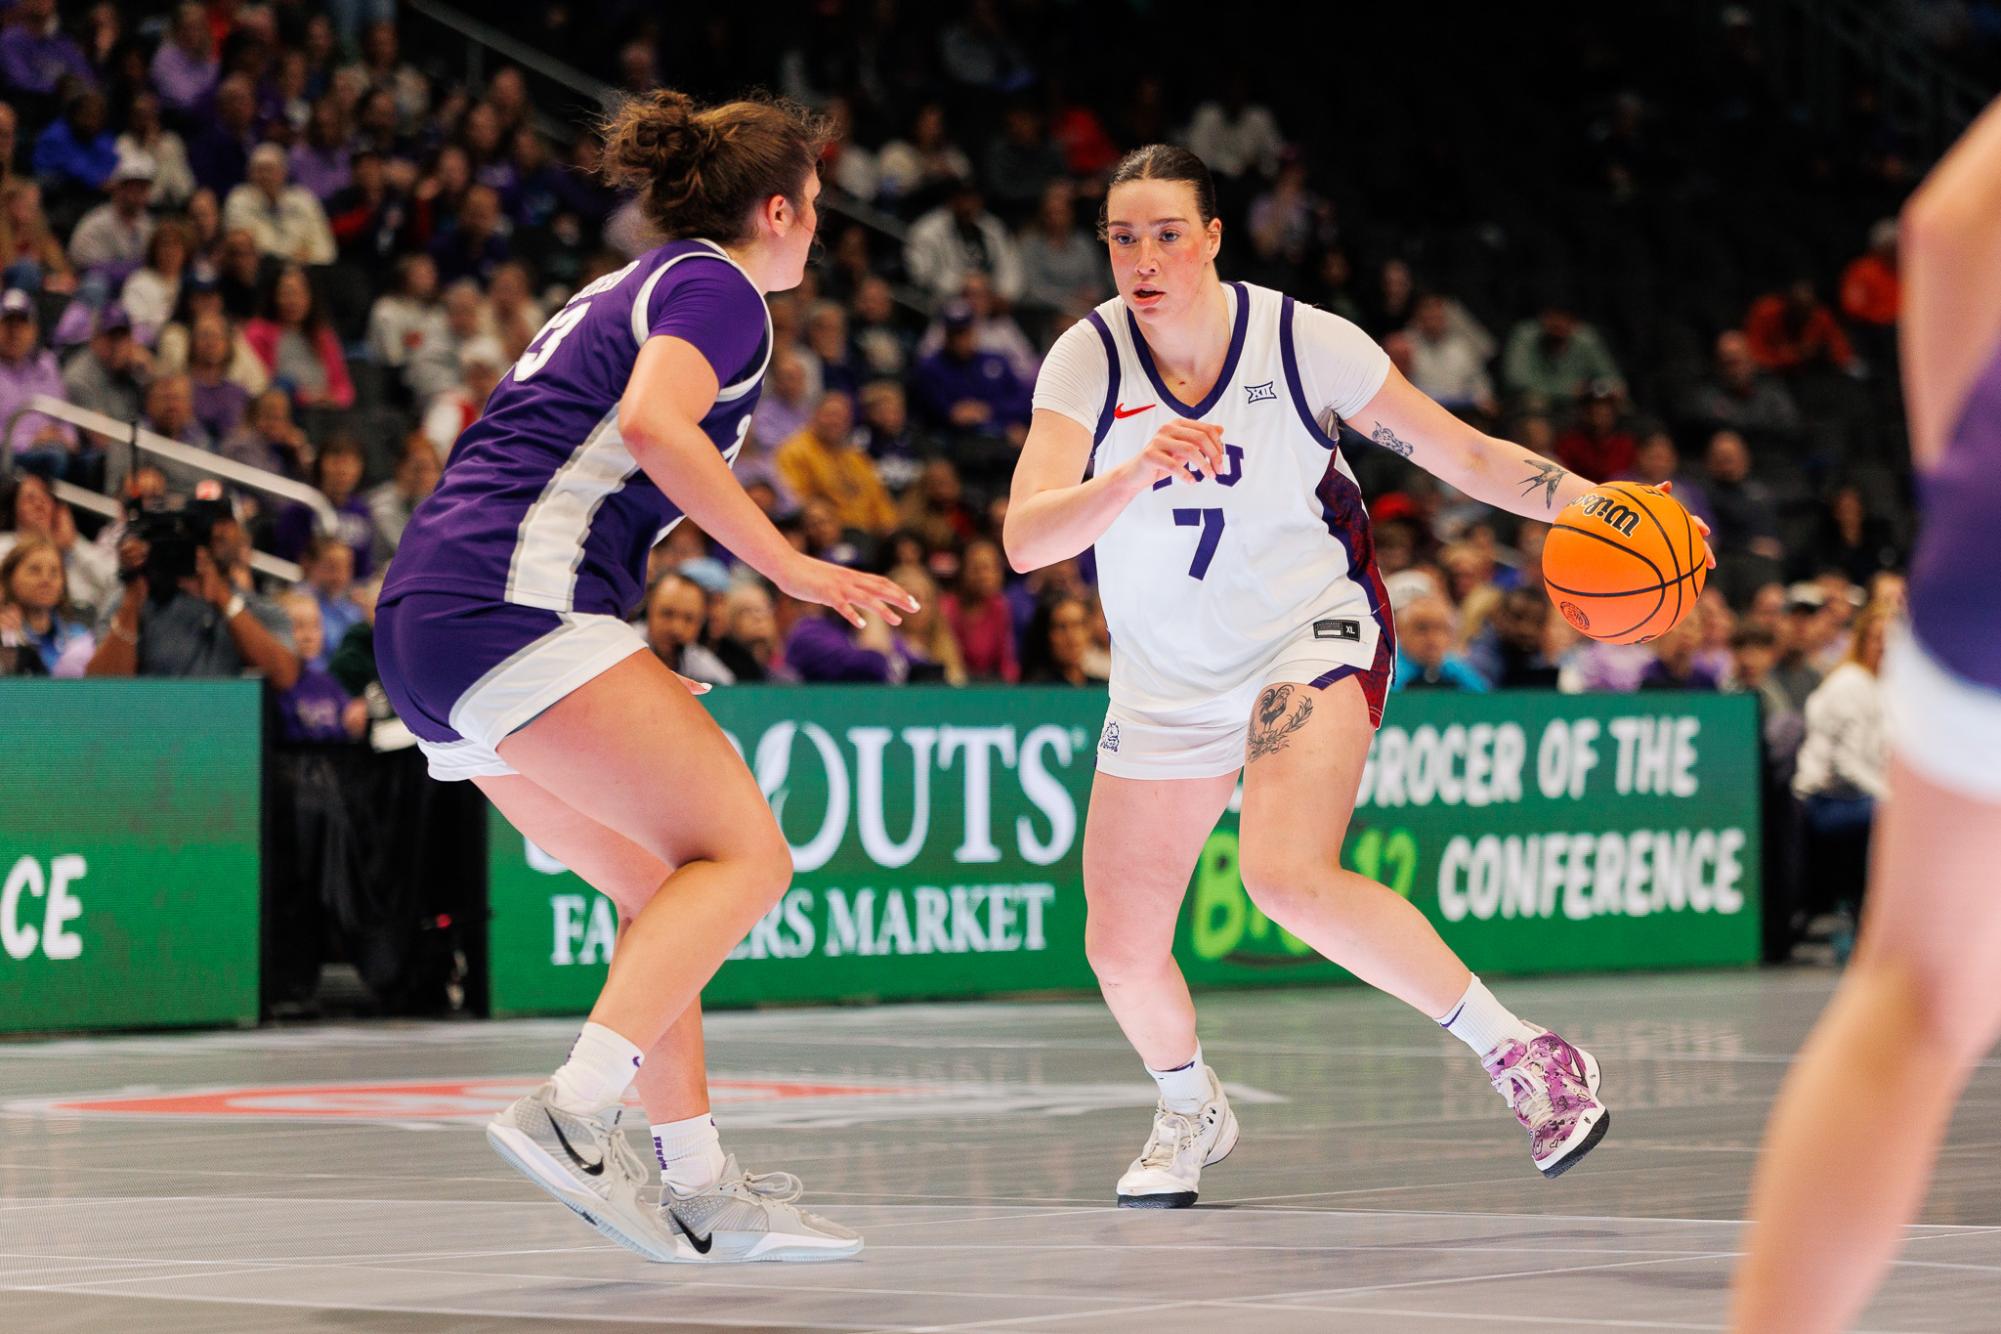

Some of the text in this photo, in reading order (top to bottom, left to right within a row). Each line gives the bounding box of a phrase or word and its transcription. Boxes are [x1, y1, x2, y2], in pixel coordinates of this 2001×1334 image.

[1172, 507, 1226, 582] 7
[1345, 625, 1356, 635] XL
[523, 720, 1078, 874] OUTS
[1536, 718, 1600, 799] OF
[1608, 716, 1701, 798] THE
[1437, 828, 1746, 922] CONFERENCE
[550, 883, 1056, 966] FARS MARKET
